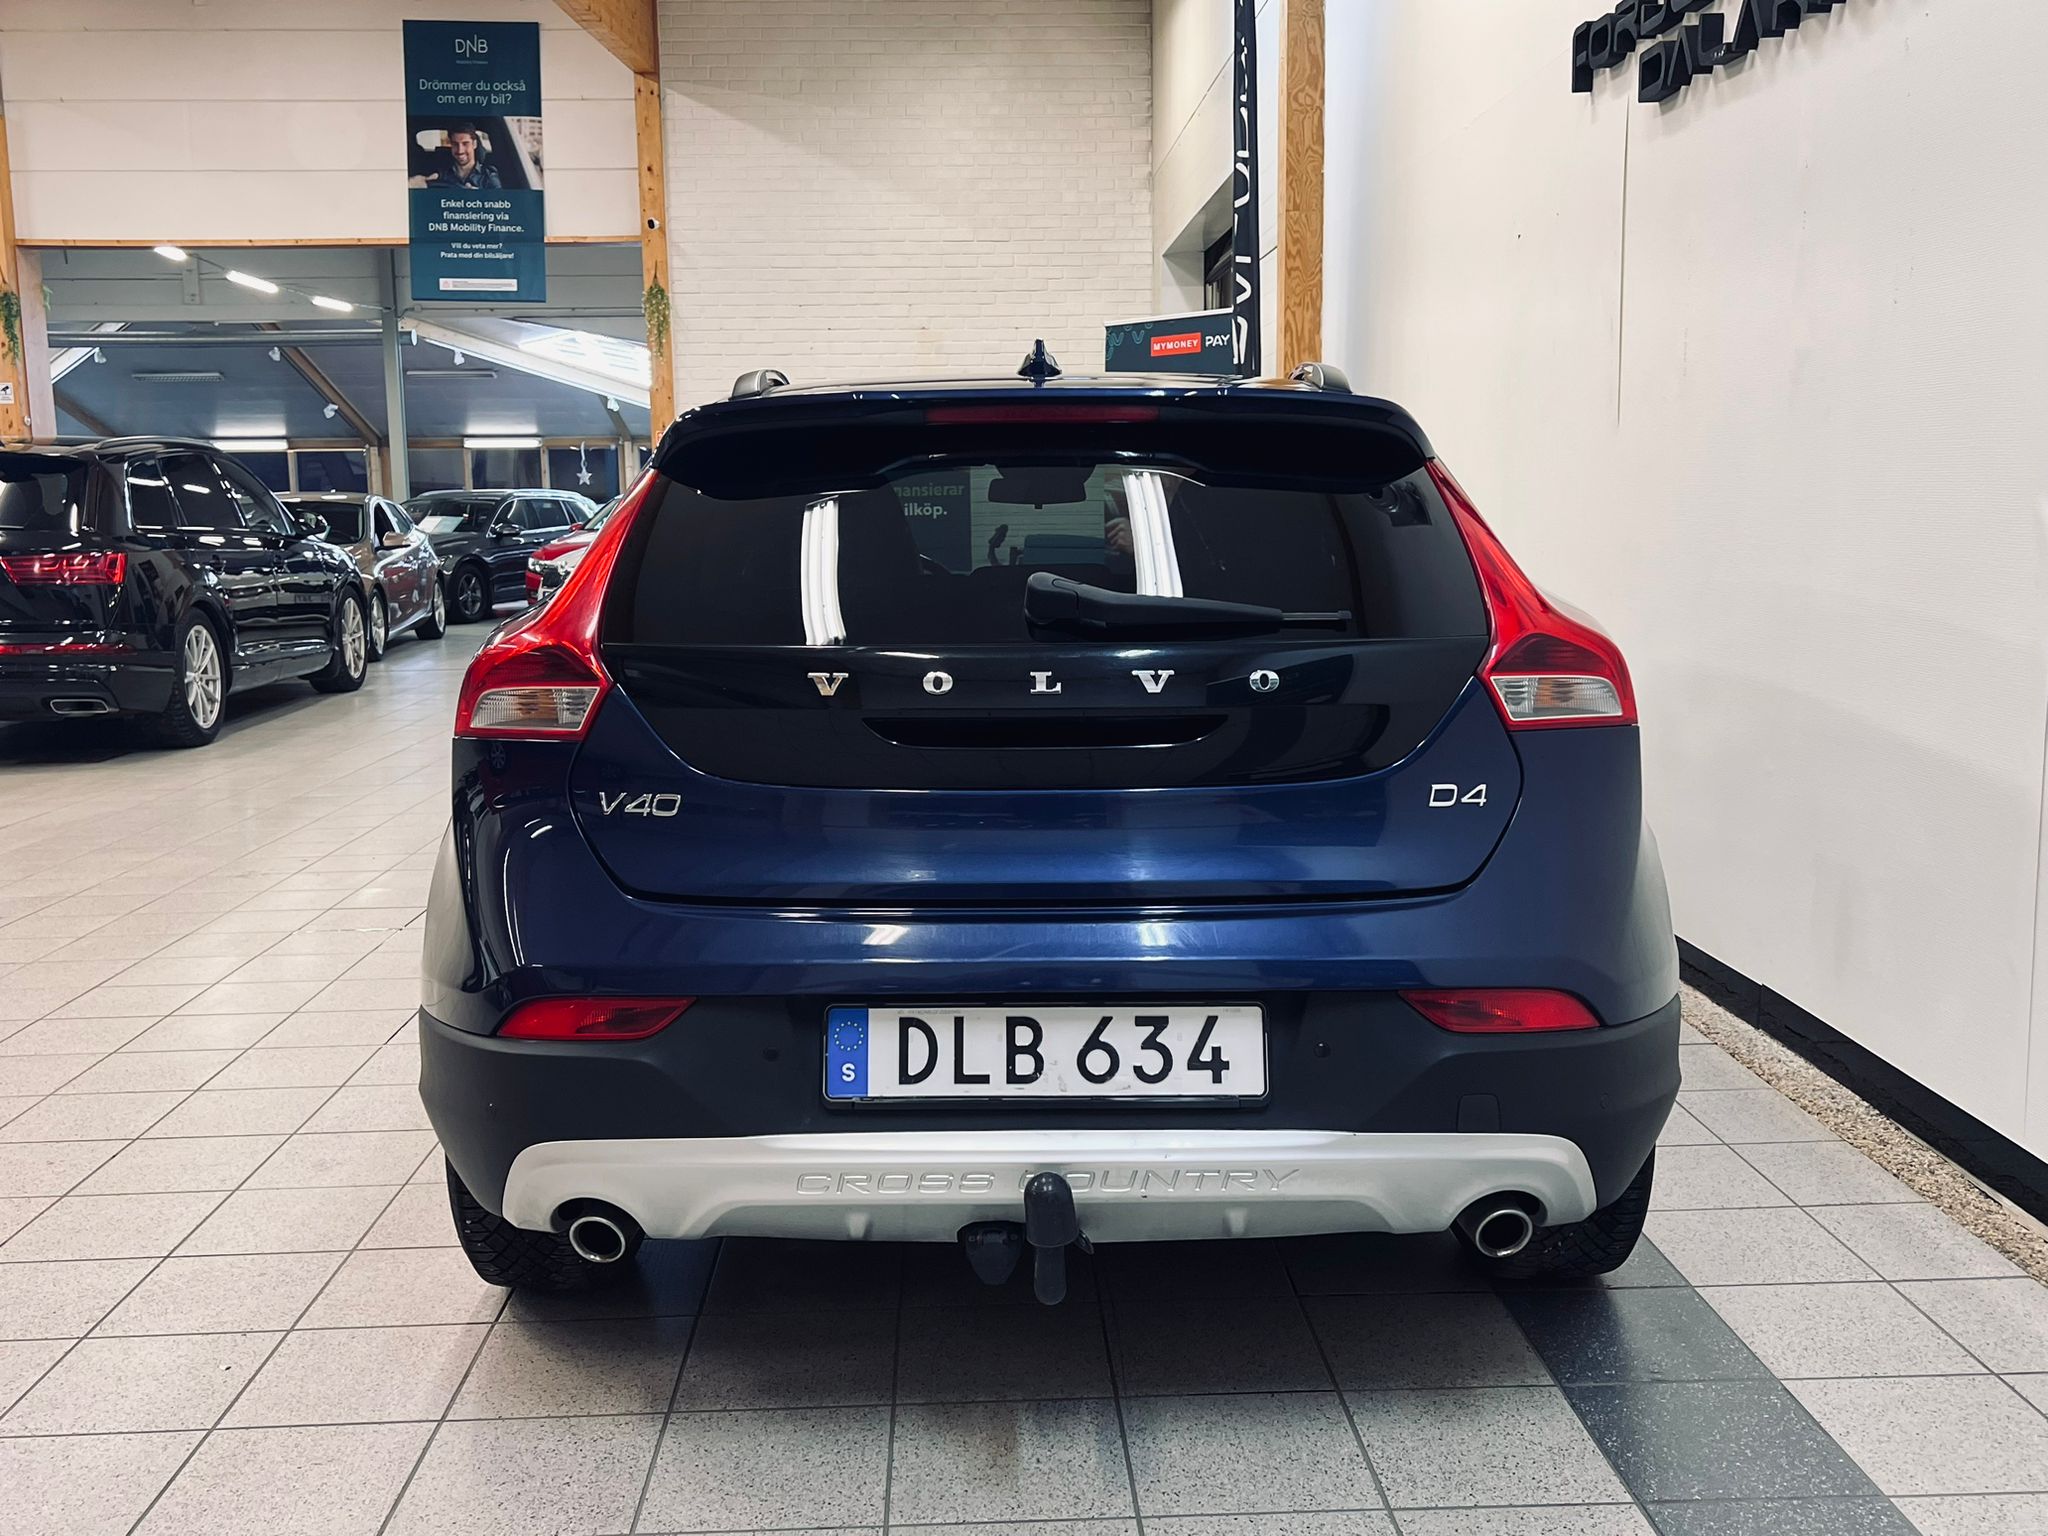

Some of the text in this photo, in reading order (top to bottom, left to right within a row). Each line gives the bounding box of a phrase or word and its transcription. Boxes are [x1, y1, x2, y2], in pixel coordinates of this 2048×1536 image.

[455, 34, 488, 58] DNB
[419, 79, 526, 91] Drömmer du också
[437, 93, 512, 106] om en ny bil?
[440, 199, 511, 209] Enkel och snabb
[443, 211, 510, 222] finansiering via
[428, 222, 525, 234] DNB Mobility Finance.
[440, 251, 457, 259] Prata
[1152, 333, 1231, 351] MYMONEY PAY
[807, 669, 1281, 696] VOLVO
[599, 791, 682, 818] V40
[1429, 783, 1488, 807] D4
[898, 1015, 1231, 1085] DLB 634
[841, 1062, 856, 1083] S
[796, 1171, 995, 1195] CROSS
